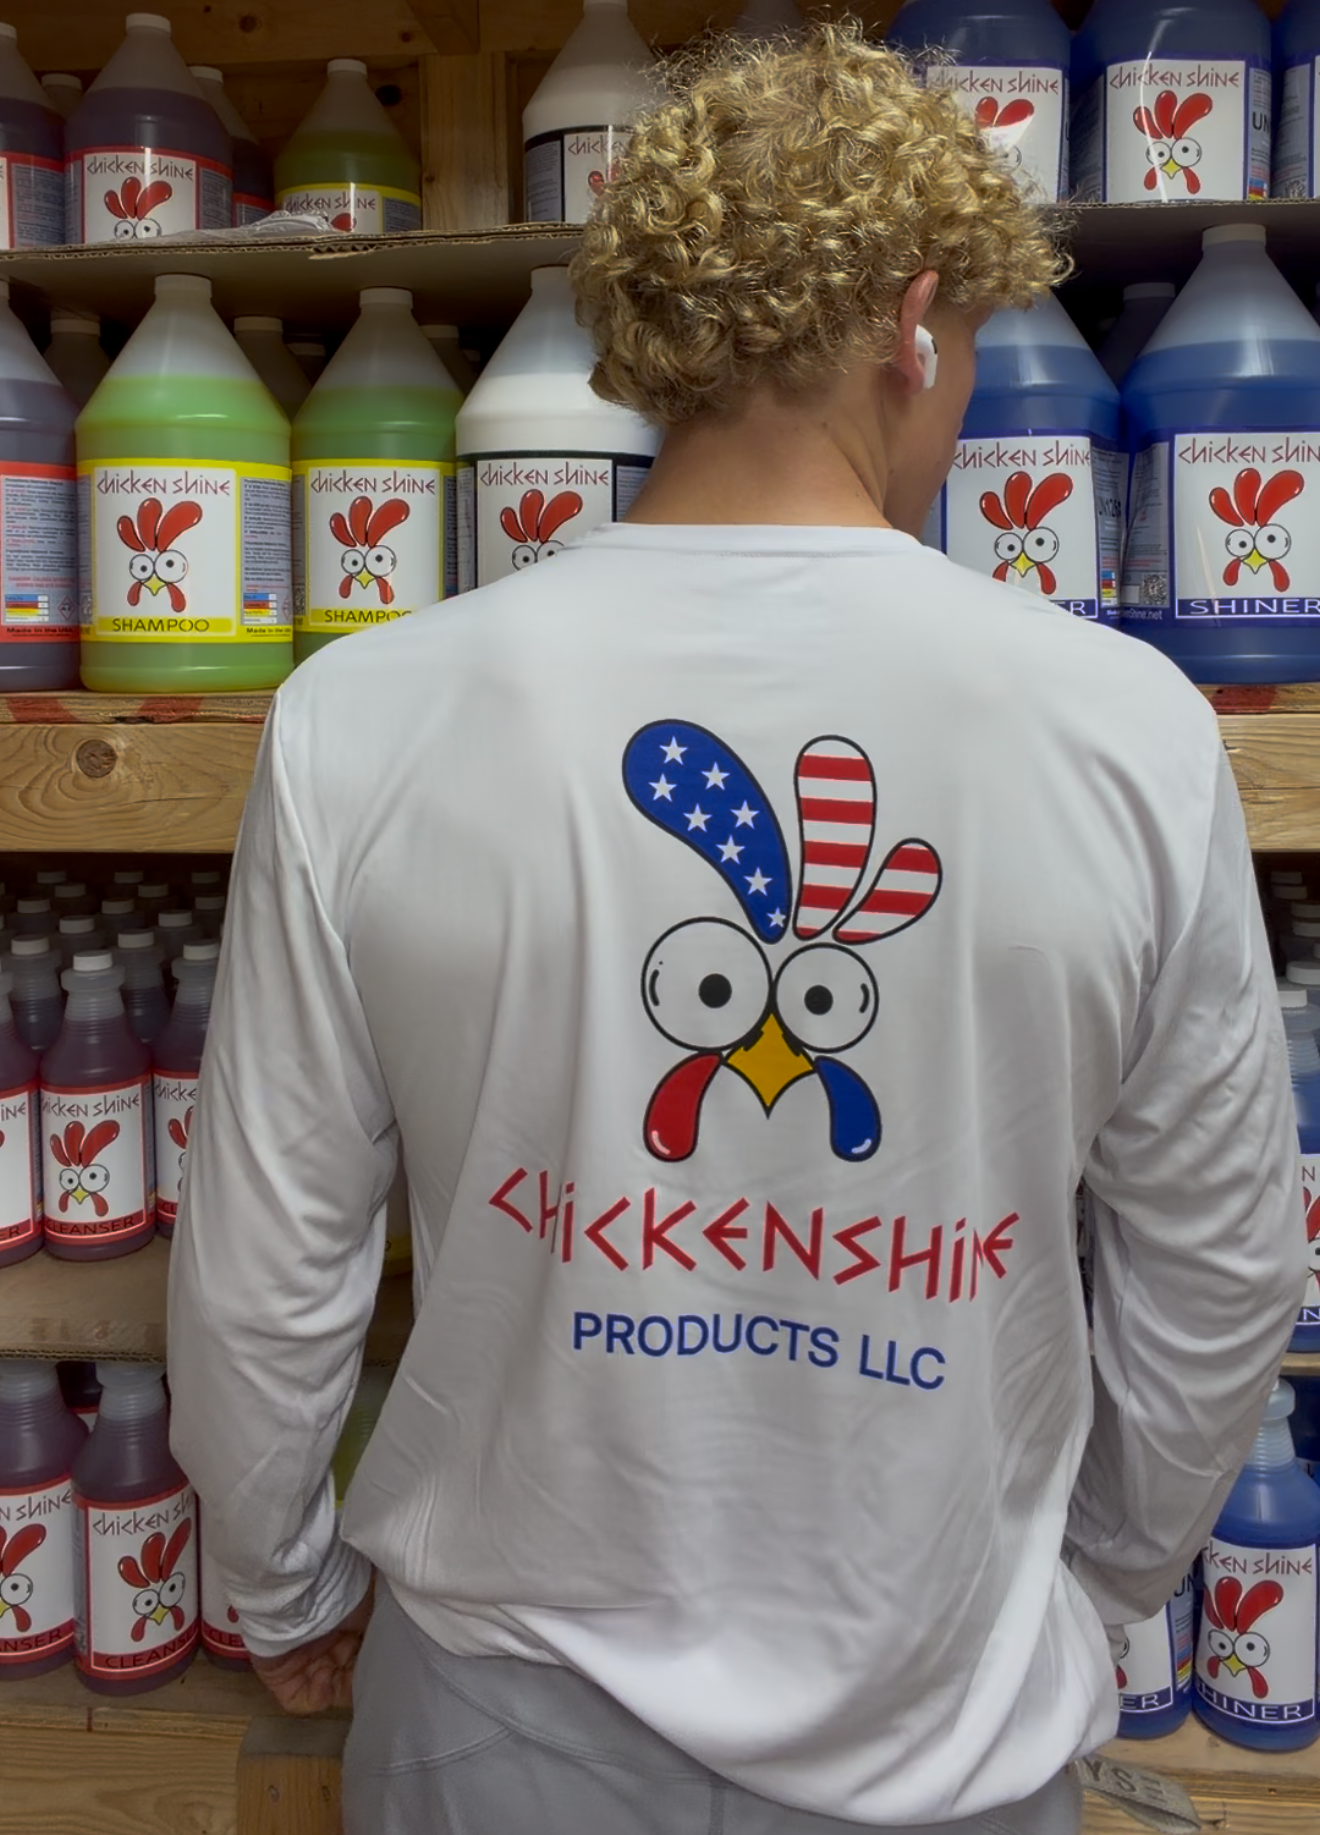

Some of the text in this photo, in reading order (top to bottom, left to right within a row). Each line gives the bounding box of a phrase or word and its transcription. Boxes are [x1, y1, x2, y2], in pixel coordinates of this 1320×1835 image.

[1189, 598, 1320, 615] SHINER
[112, 617, 210, 632] SHAMPOO
[571, 1310, 947, 1391] PRODUCTS LLC
